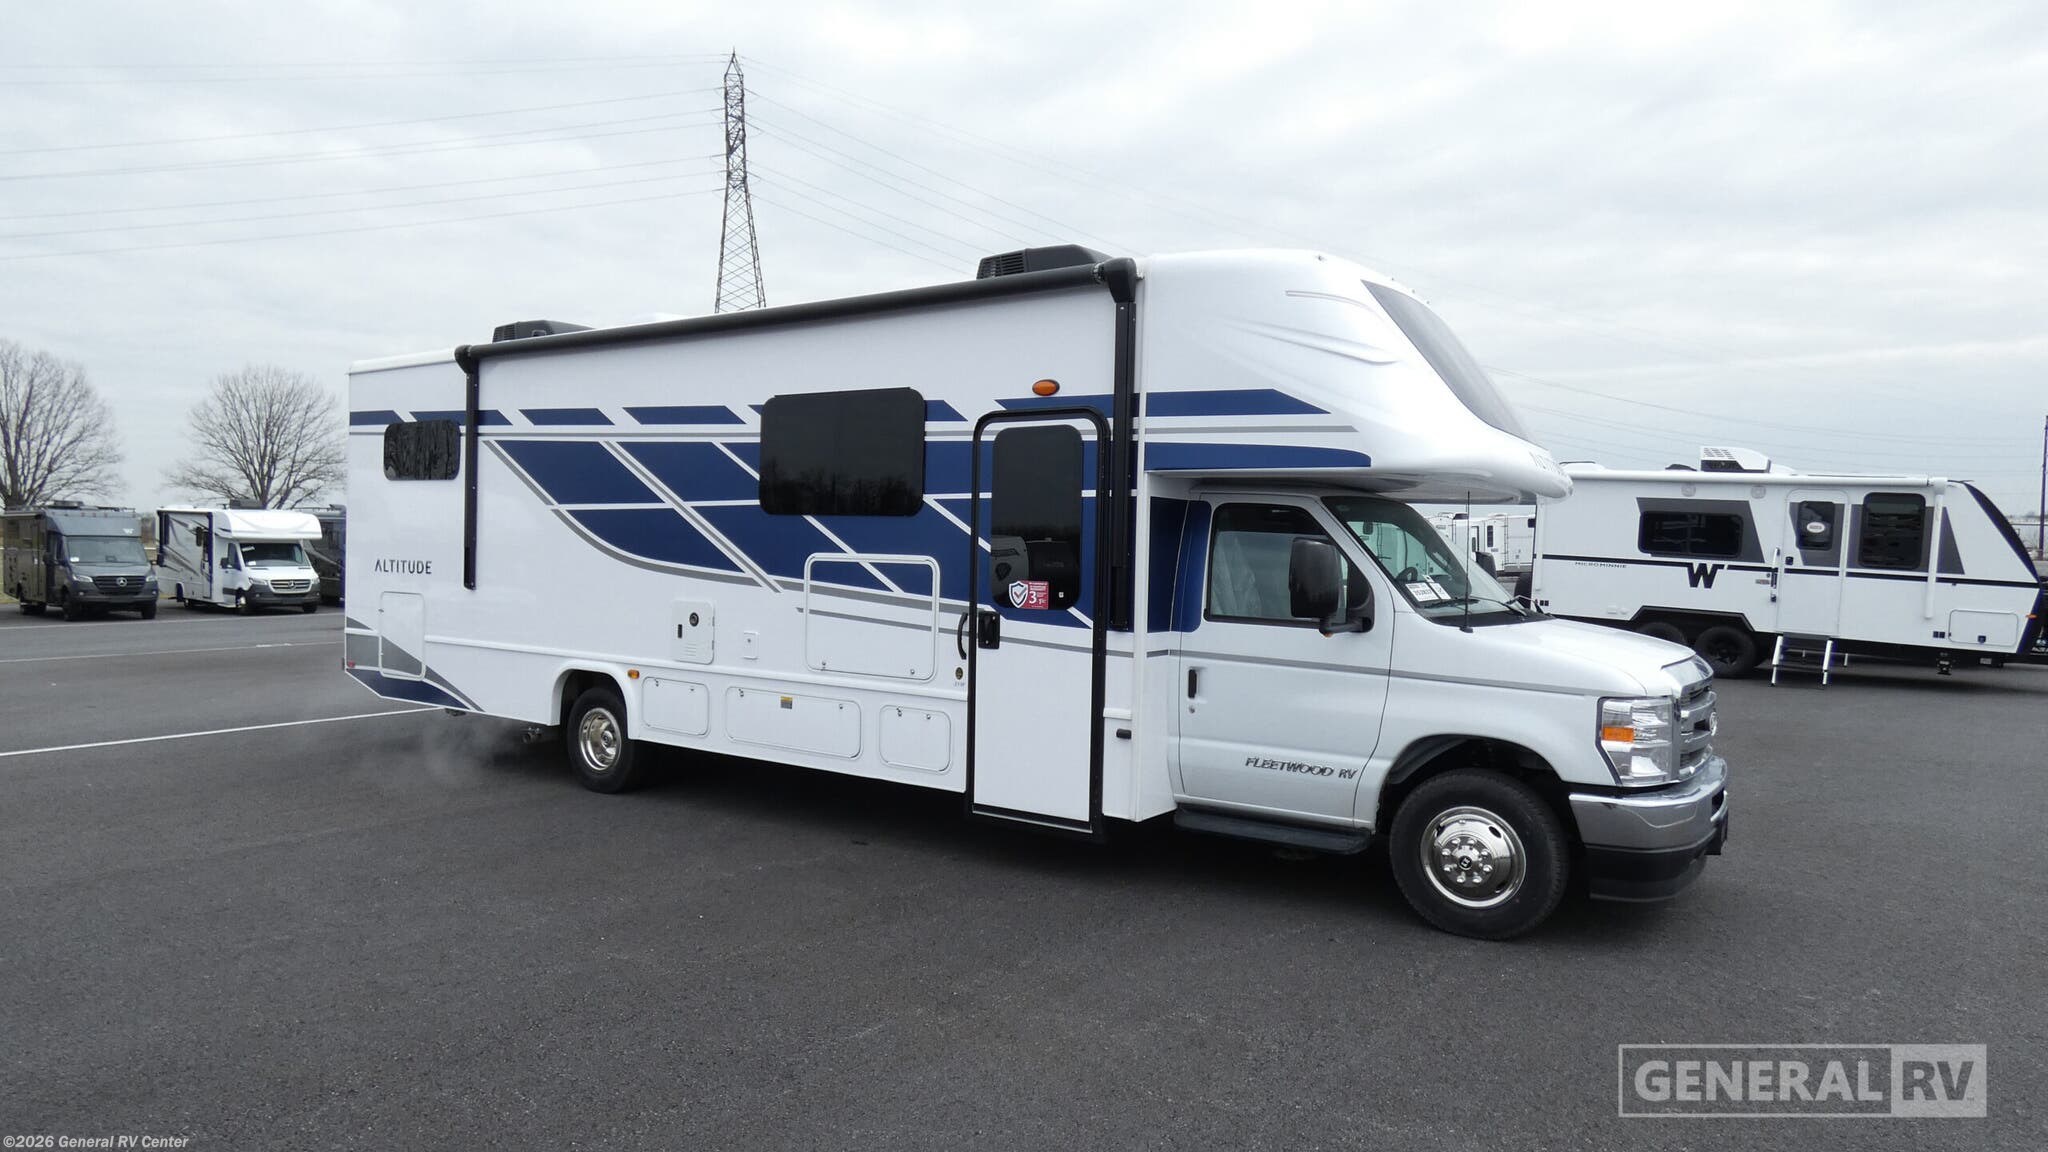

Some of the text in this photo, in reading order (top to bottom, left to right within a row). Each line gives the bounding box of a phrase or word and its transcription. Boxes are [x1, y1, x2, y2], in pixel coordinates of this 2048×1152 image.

[374, 558, 433, 575] ALTITUDE
[1687, 562, 1723, 589] W
[1028, 590, 1037, 605] 3
[1245, 756, 1358, 780] FLEETWOOD RV
